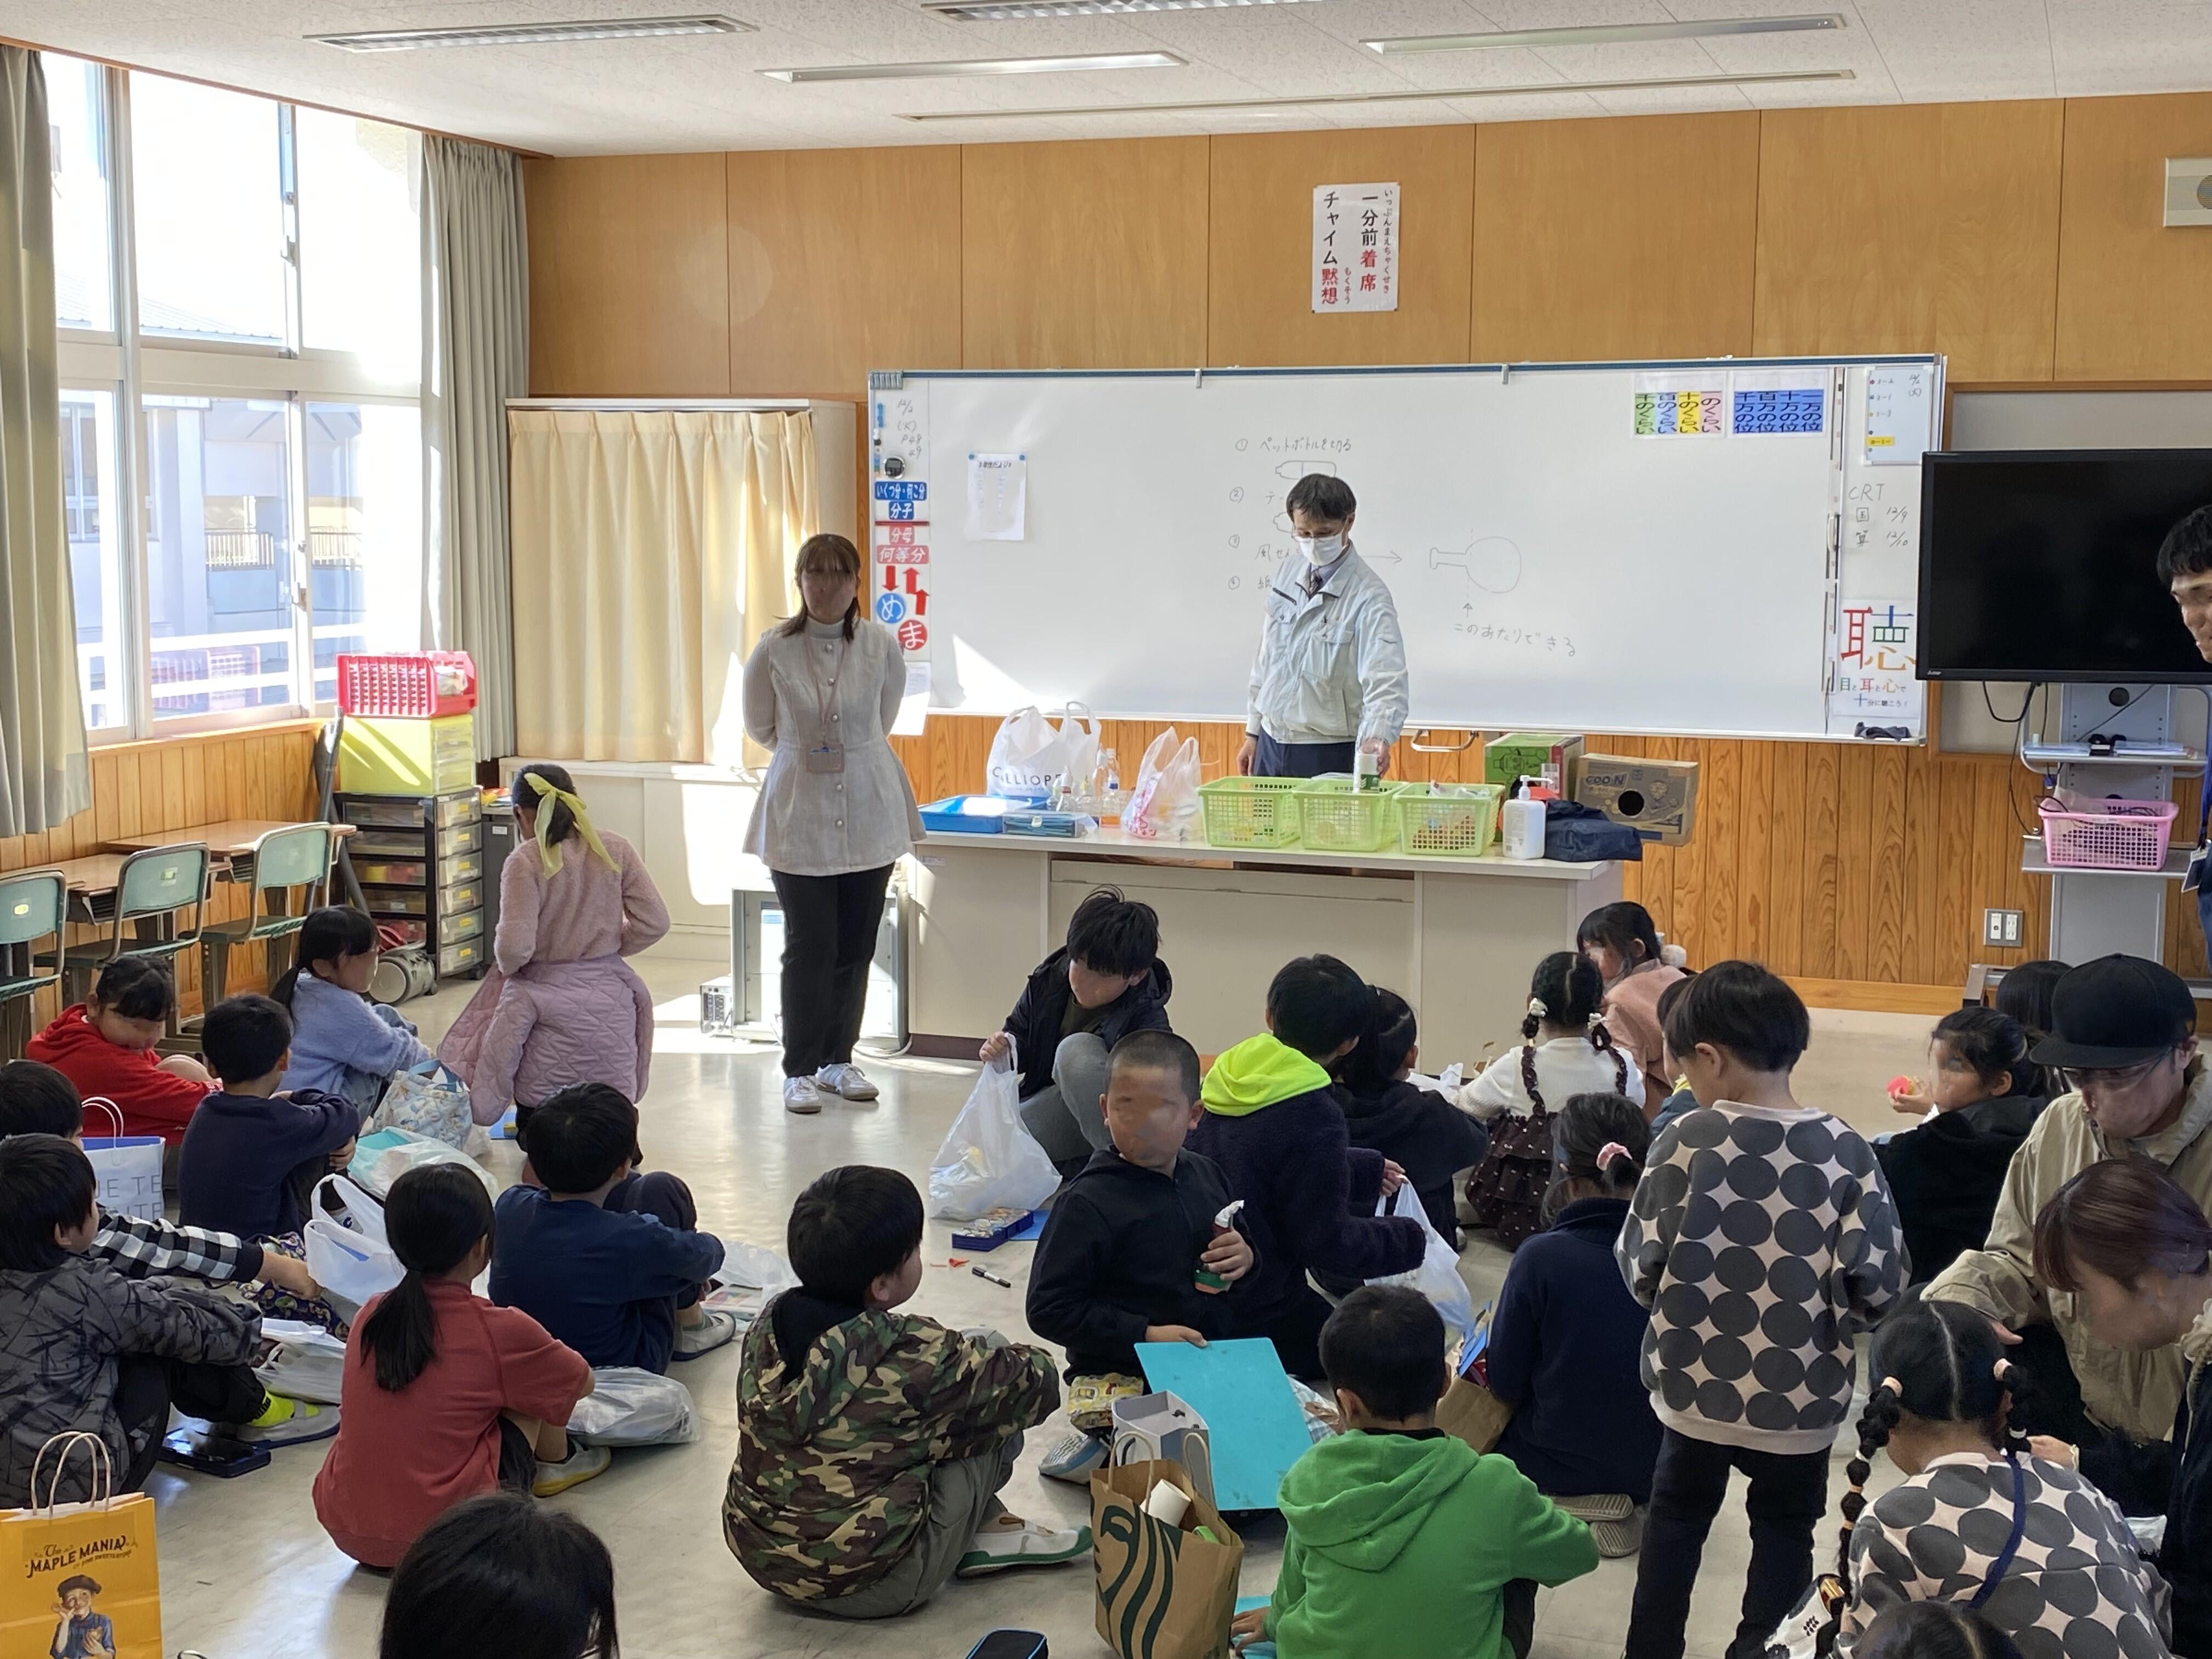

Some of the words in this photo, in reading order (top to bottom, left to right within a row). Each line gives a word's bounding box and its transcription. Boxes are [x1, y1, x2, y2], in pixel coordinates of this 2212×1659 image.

[1321, 191, 1340, 304] チャイム黙想
[1359, 195, 1379, 292] 一分前着席
[1344, 267, 1352, 304] もくそう
[1848, 483, 1885, 501] CRT
[890, 503, 912, 519] 分子
[890, 527, 913, 543] 分母
[879, 546, 926, 563] 何等分
[881, 595, 904, 621] め
[899, 622, 925, 649] ま
[1454, 623, 1576, 657] このあたりできる
[1841, 678, 1906, 693] 目と耳と心で
[27, 1550, 77, 1578] MAPLE
[80, 1535, 126, 1560] MANIA
